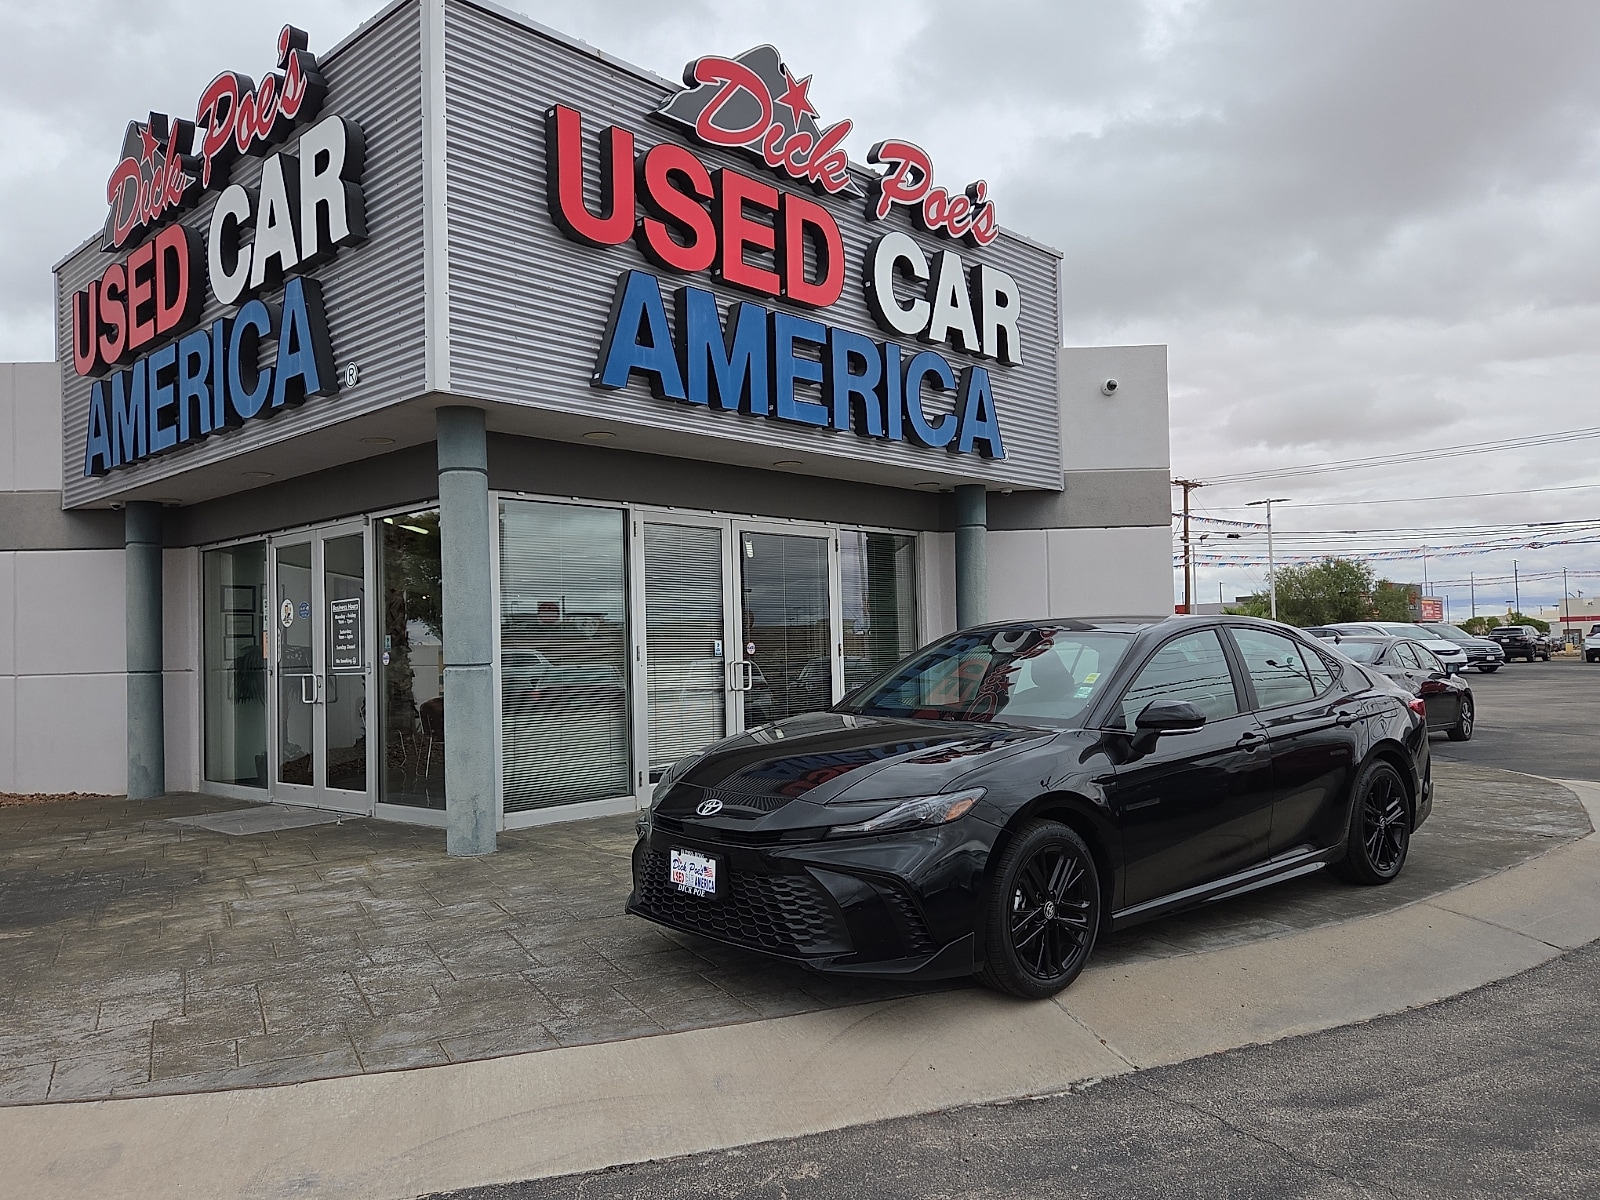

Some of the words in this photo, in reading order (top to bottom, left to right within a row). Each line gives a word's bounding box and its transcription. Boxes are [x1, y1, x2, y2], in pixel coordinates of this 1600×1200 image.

[107, 118, 184, 248] Dick
[197, 24, 308, 188] Poe's
[694, 56, 854, 193] Dick
[876, 140, 998, 247] Poe's
[73, 223, 190, 377] USED
[208, 115, 349, 305] CAR
[555, 104, 846, 308] USED
[873, 232, 1023, 366] CAR
[85, 277, 321, 477] AMERICA
[601, 269, 1005, 460] AMERICA
[673, 859, 687, 872] Dick
[678, 884, 692, 894] DICK
[693, 888, 705, 897] POE
